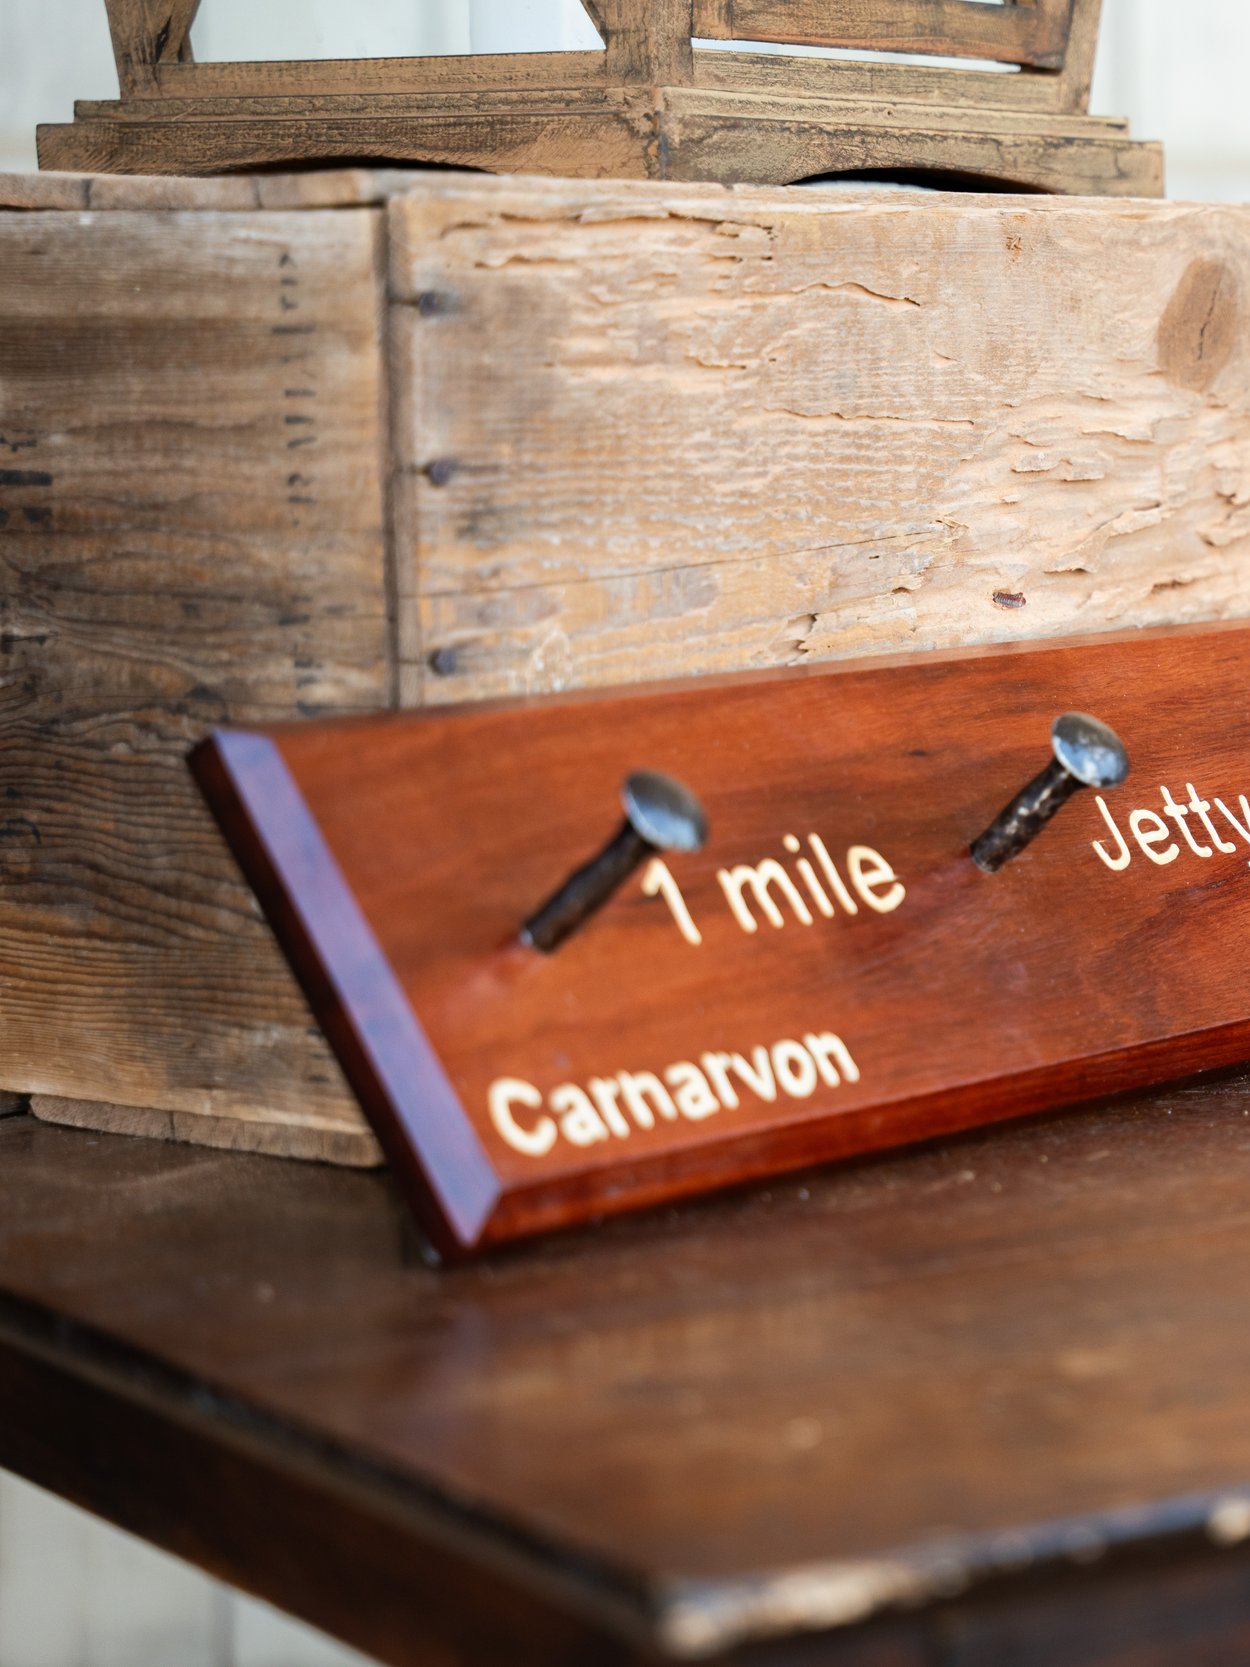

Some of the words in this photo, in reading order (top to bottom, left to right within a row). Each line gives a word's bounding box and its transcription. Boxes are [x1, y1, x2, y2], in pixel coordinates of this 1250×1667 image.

[641, 857, 703, 946] 1
[716, 831, 907, 934] mile
[487, 1031, 861, 1157] Carnarvon
